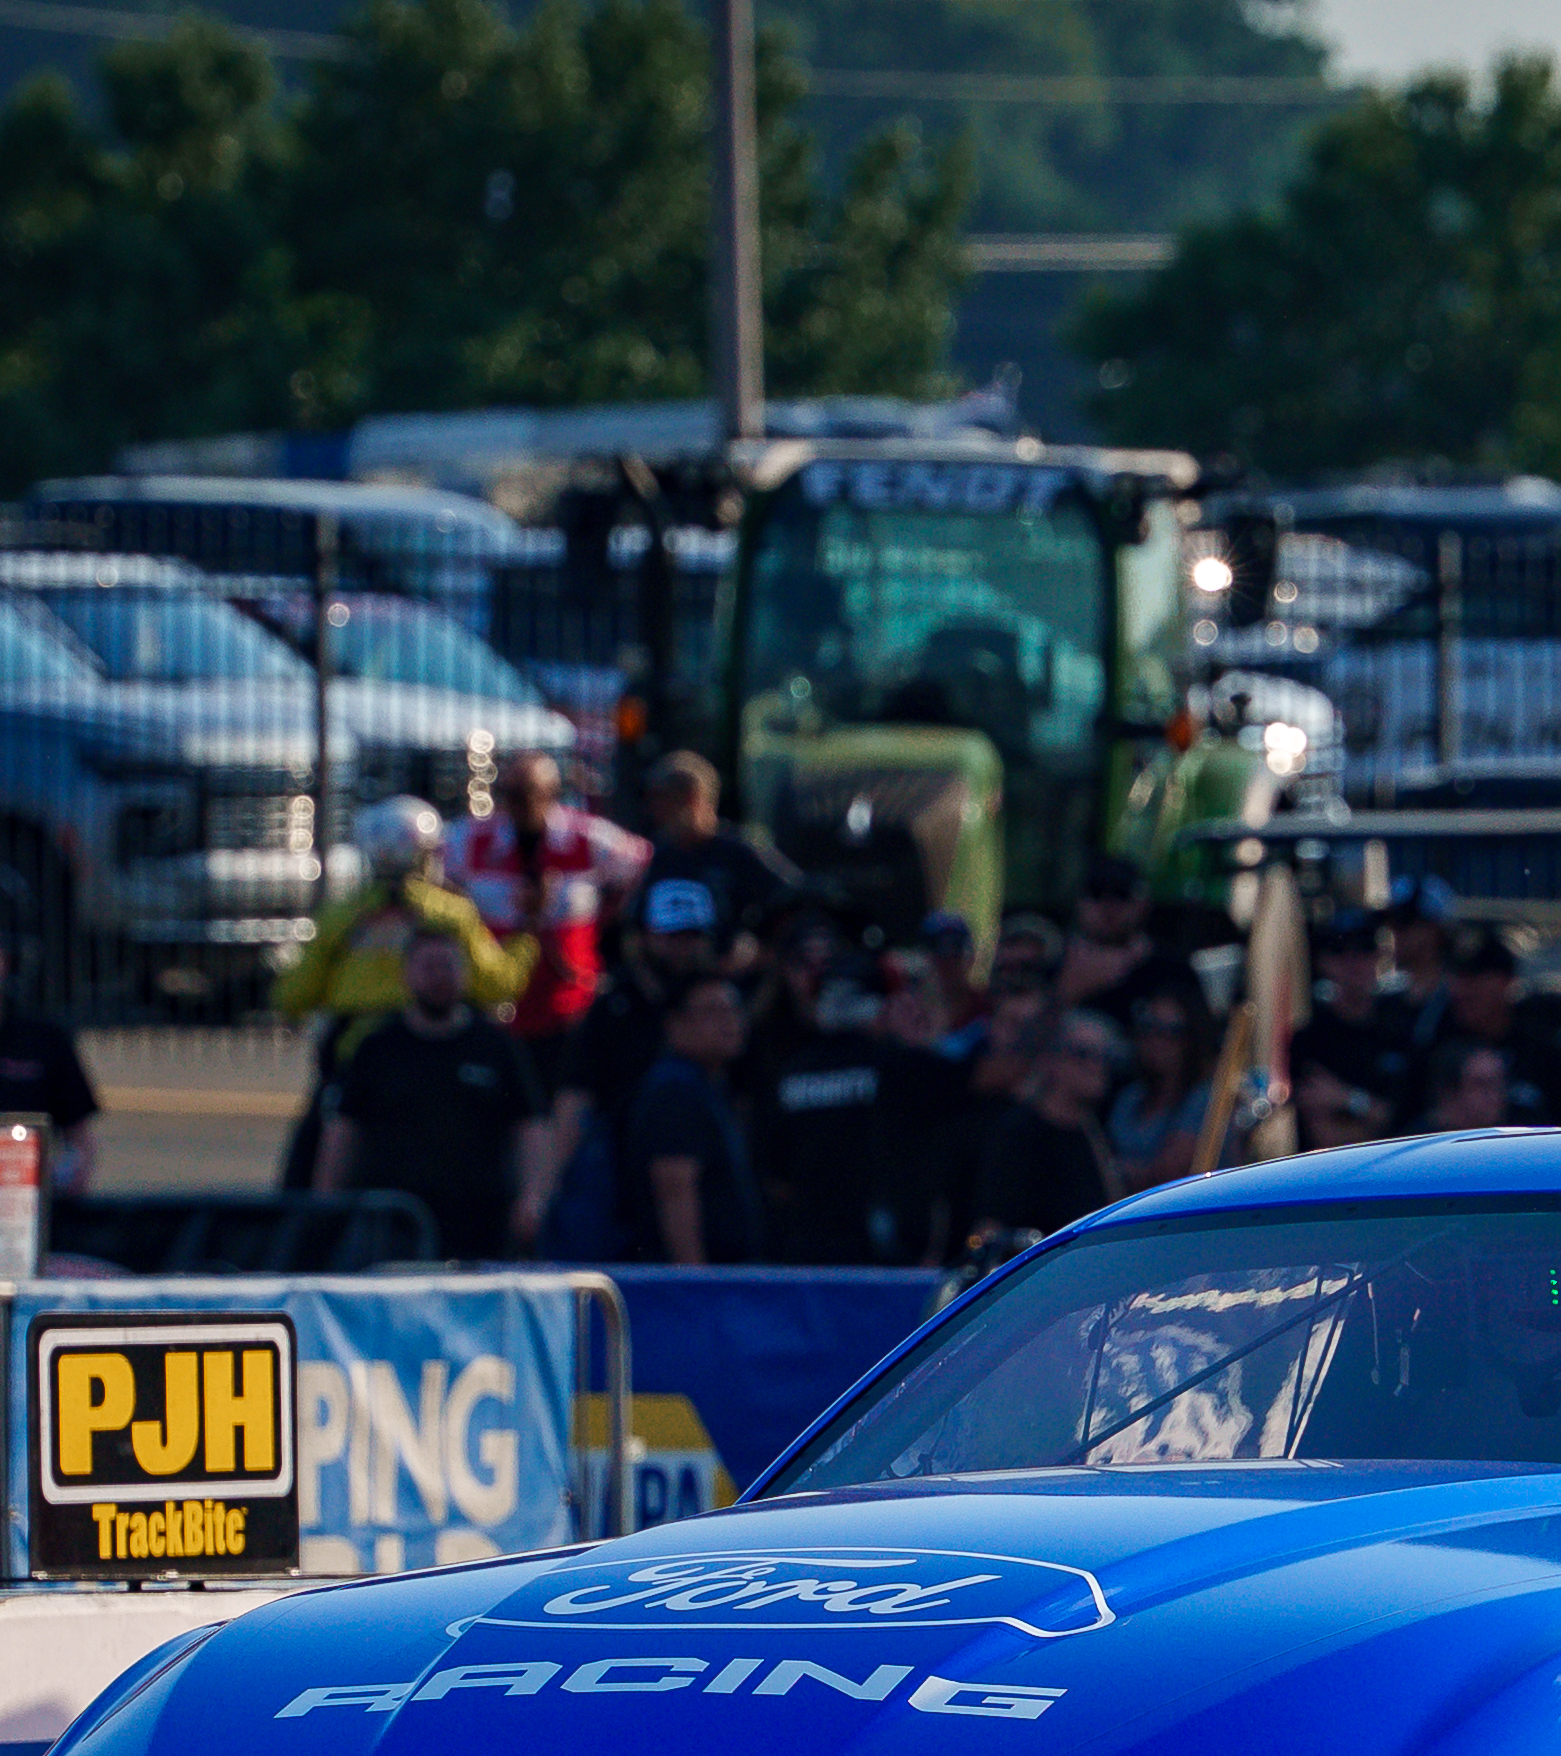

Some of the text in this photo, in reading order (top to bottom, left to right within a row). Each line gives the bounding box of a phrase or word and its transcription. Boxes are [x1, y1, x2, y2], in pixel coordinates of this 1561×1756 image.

[57, 1350, 276, 1476] PJH
[92, 1498, 248, 1560] TrackBite
[542, 1552, 1002, 1616] Ford
[274, 1656, 1069, 1721] RACING
